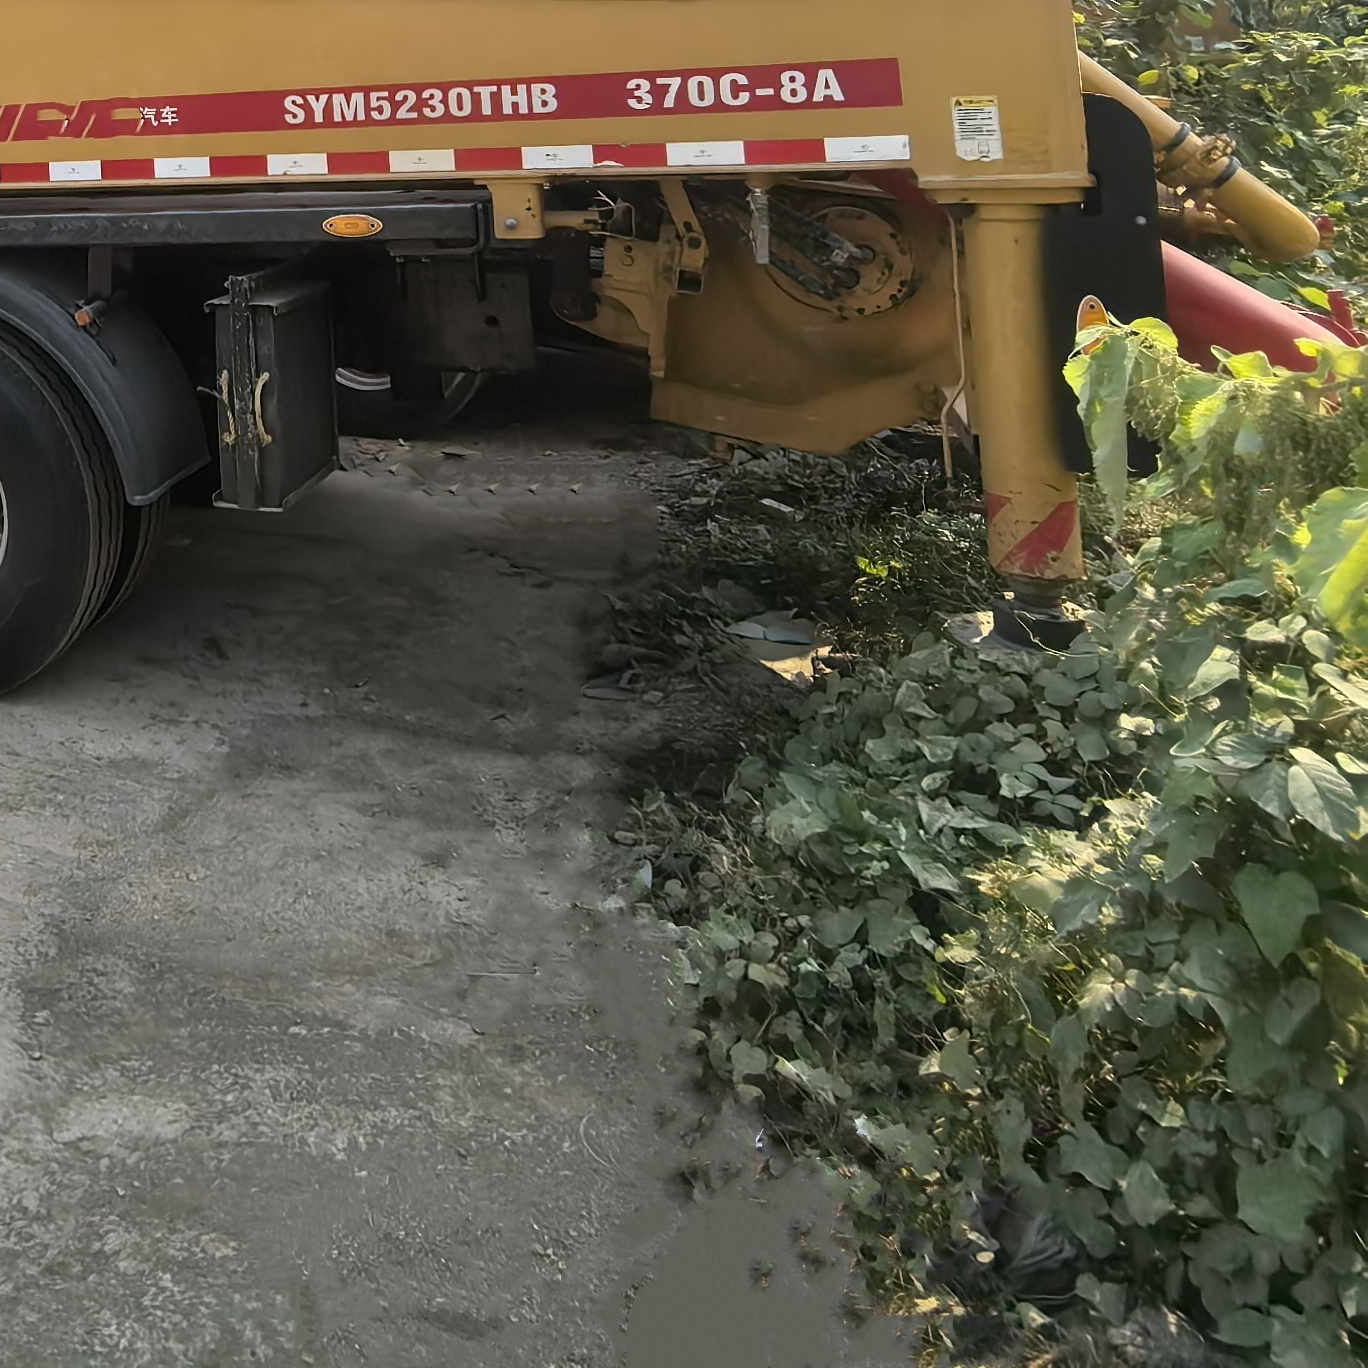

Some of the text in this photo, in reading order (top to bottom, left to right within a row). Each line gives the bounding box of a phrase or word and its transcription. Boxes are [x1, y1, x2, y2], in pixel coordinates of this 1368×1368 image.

[283, 68, 845, 124] SYM5230THB 370C-8A
[139, 106, 179, 127] 汽车
